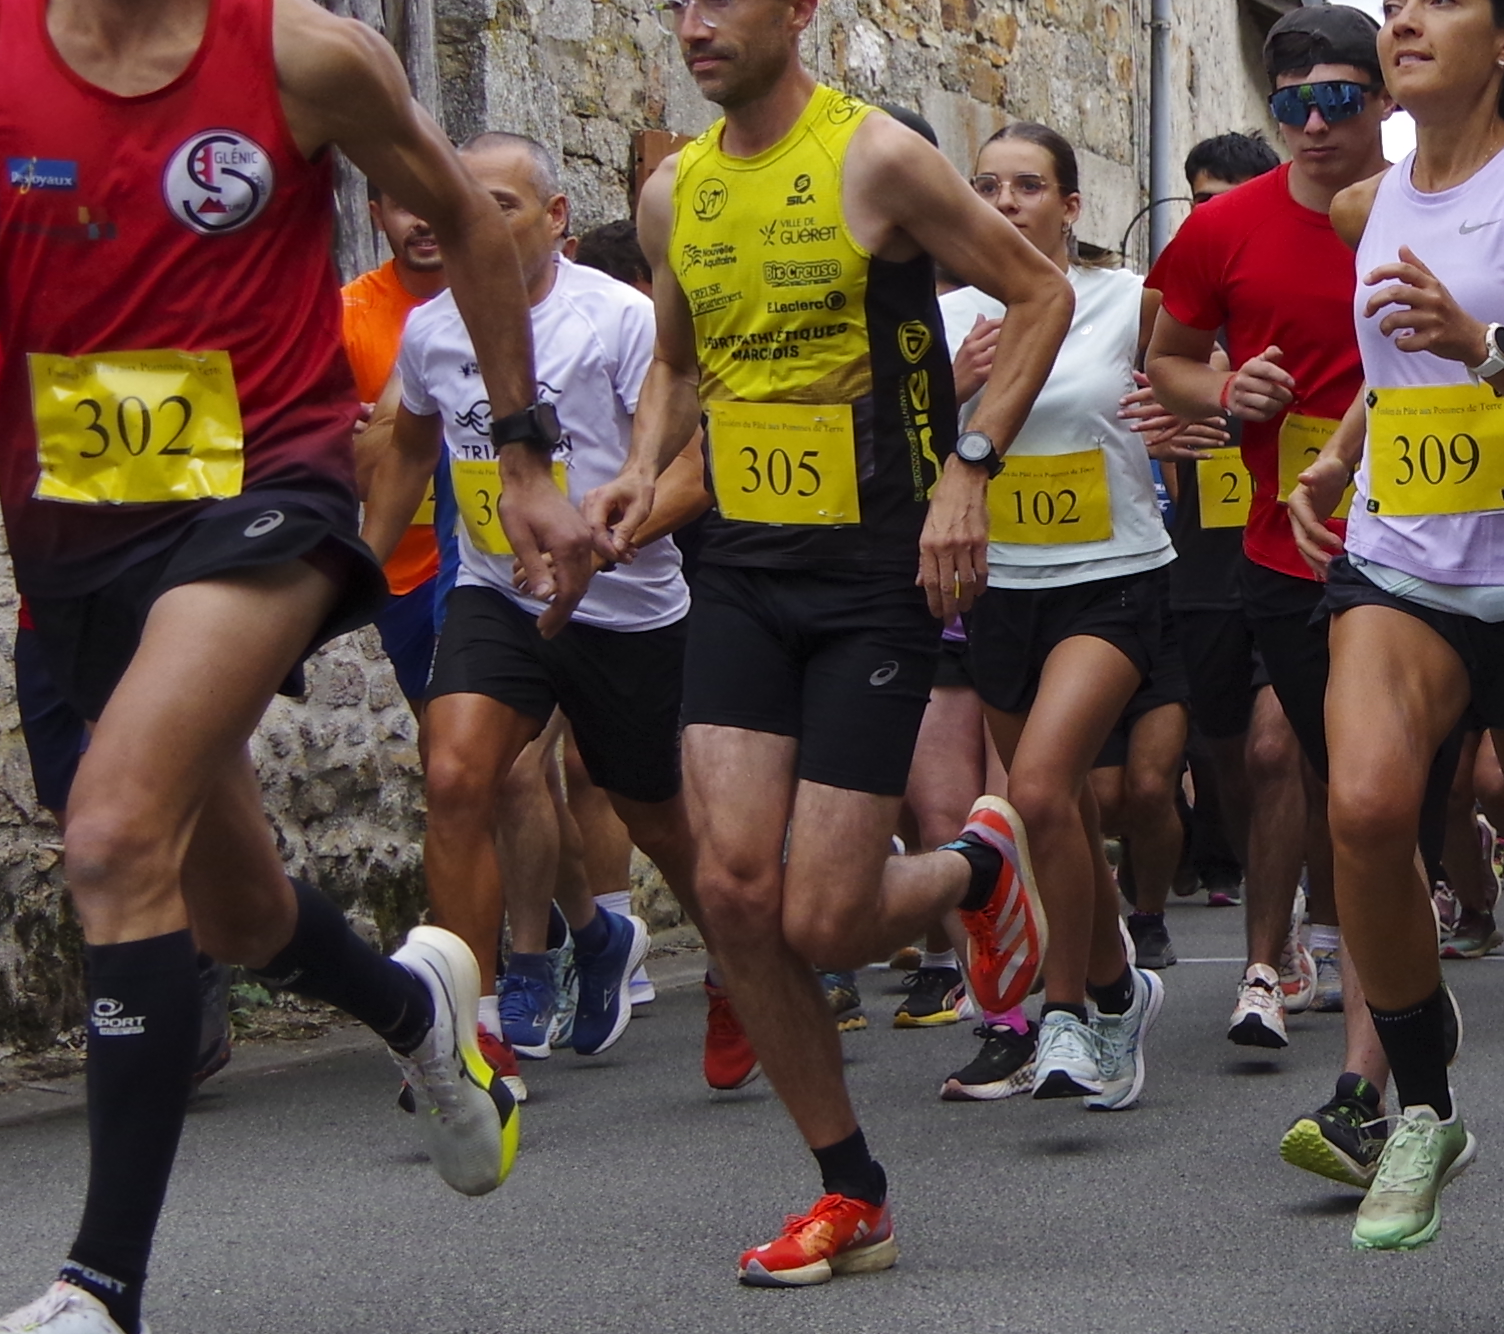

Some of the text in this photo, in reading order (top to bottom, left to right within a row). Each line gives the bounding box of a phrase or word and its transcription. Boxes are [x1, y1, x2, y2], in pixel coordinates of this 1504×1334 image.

[215, 148, 258, 164] GLÉNIC
[786, 194, 816, 206] SILA
[780, 217, 816, 228] VILLE DE
[1480, 402, 1503, 411] Terre
[74, 395, 195, 459] 302
[824, 424, 845, 434] Terre
[1392, 433, 1480, 486] 309
[739, 446, 822, 497] 305
[1012, 489, 1081, 526] 102
